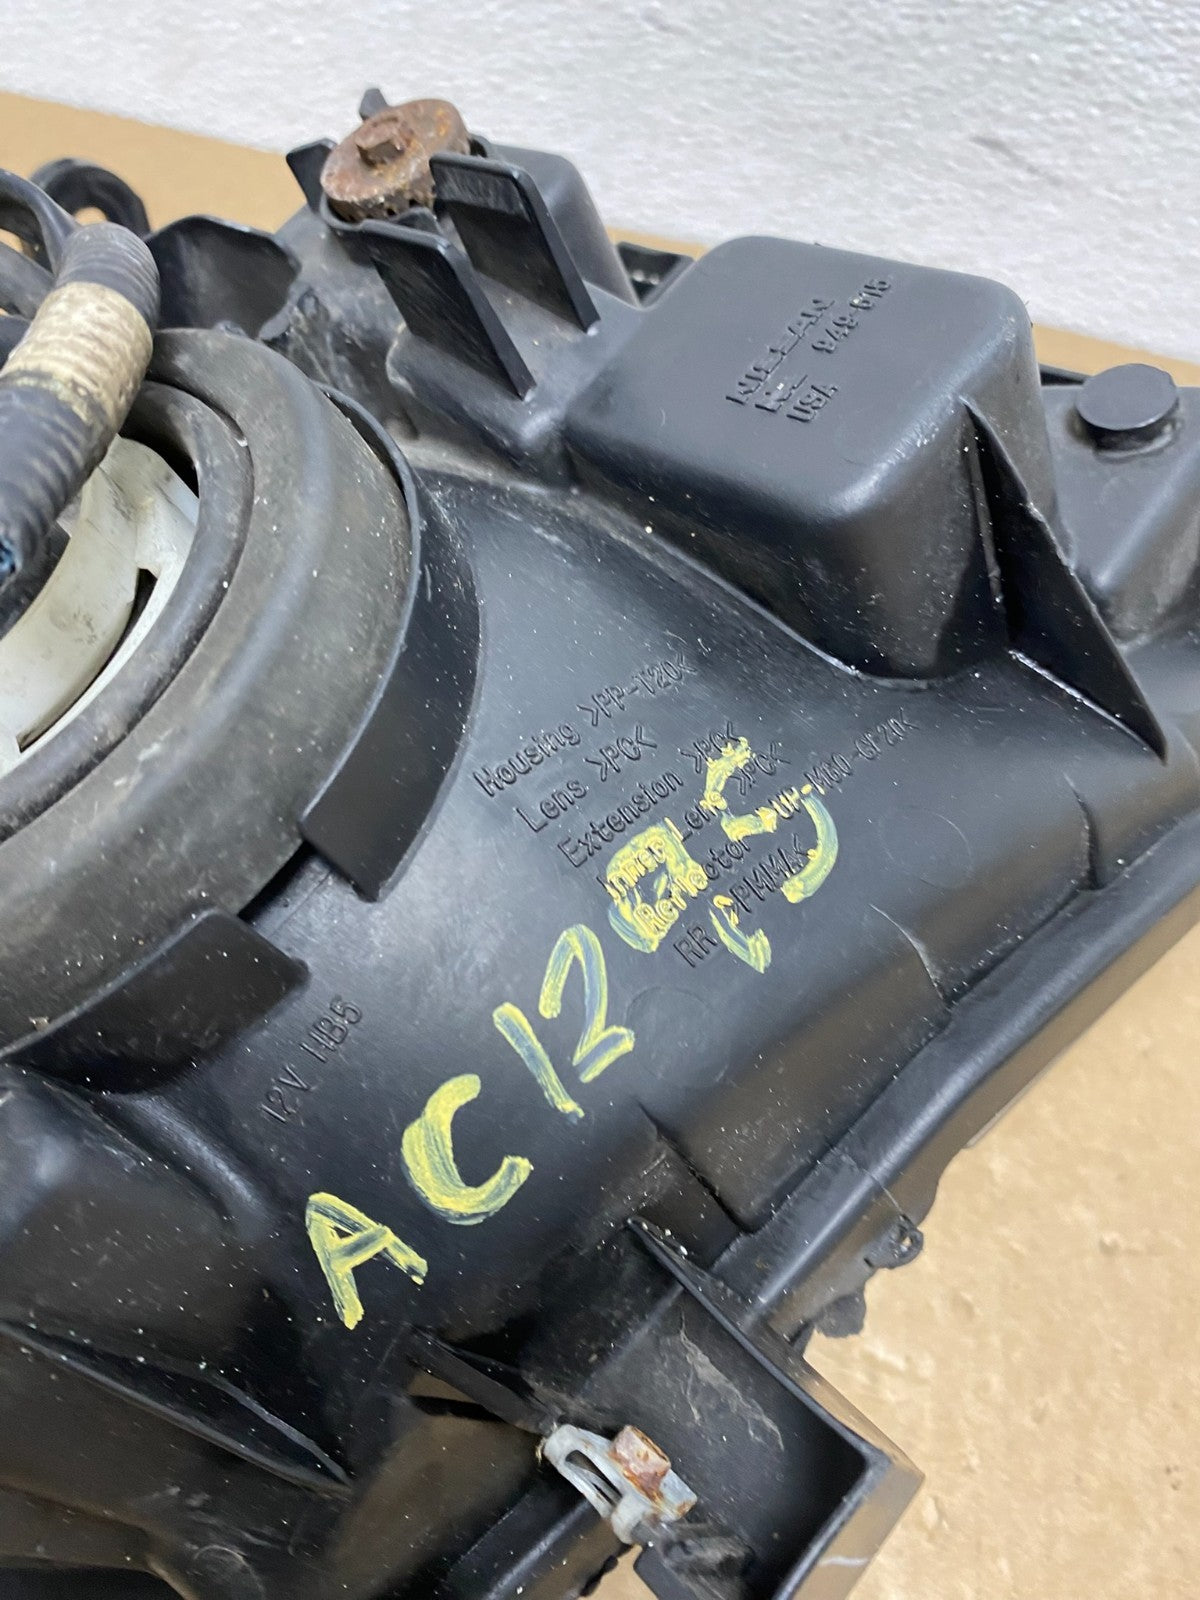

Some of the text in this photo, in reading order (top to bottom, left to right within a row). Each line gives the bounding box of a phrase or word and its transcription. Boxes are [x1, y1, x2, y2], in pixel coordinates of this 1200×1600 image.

[786, 383, 839, 423] USA
[472, 722, 581, 798] Housing
[514, 779, 588, 833] Lens
[557, 770, 684, 868] Extension
[673, 924, 719, 968] RR
[259, 997, 362, 1123] 12V HB5
